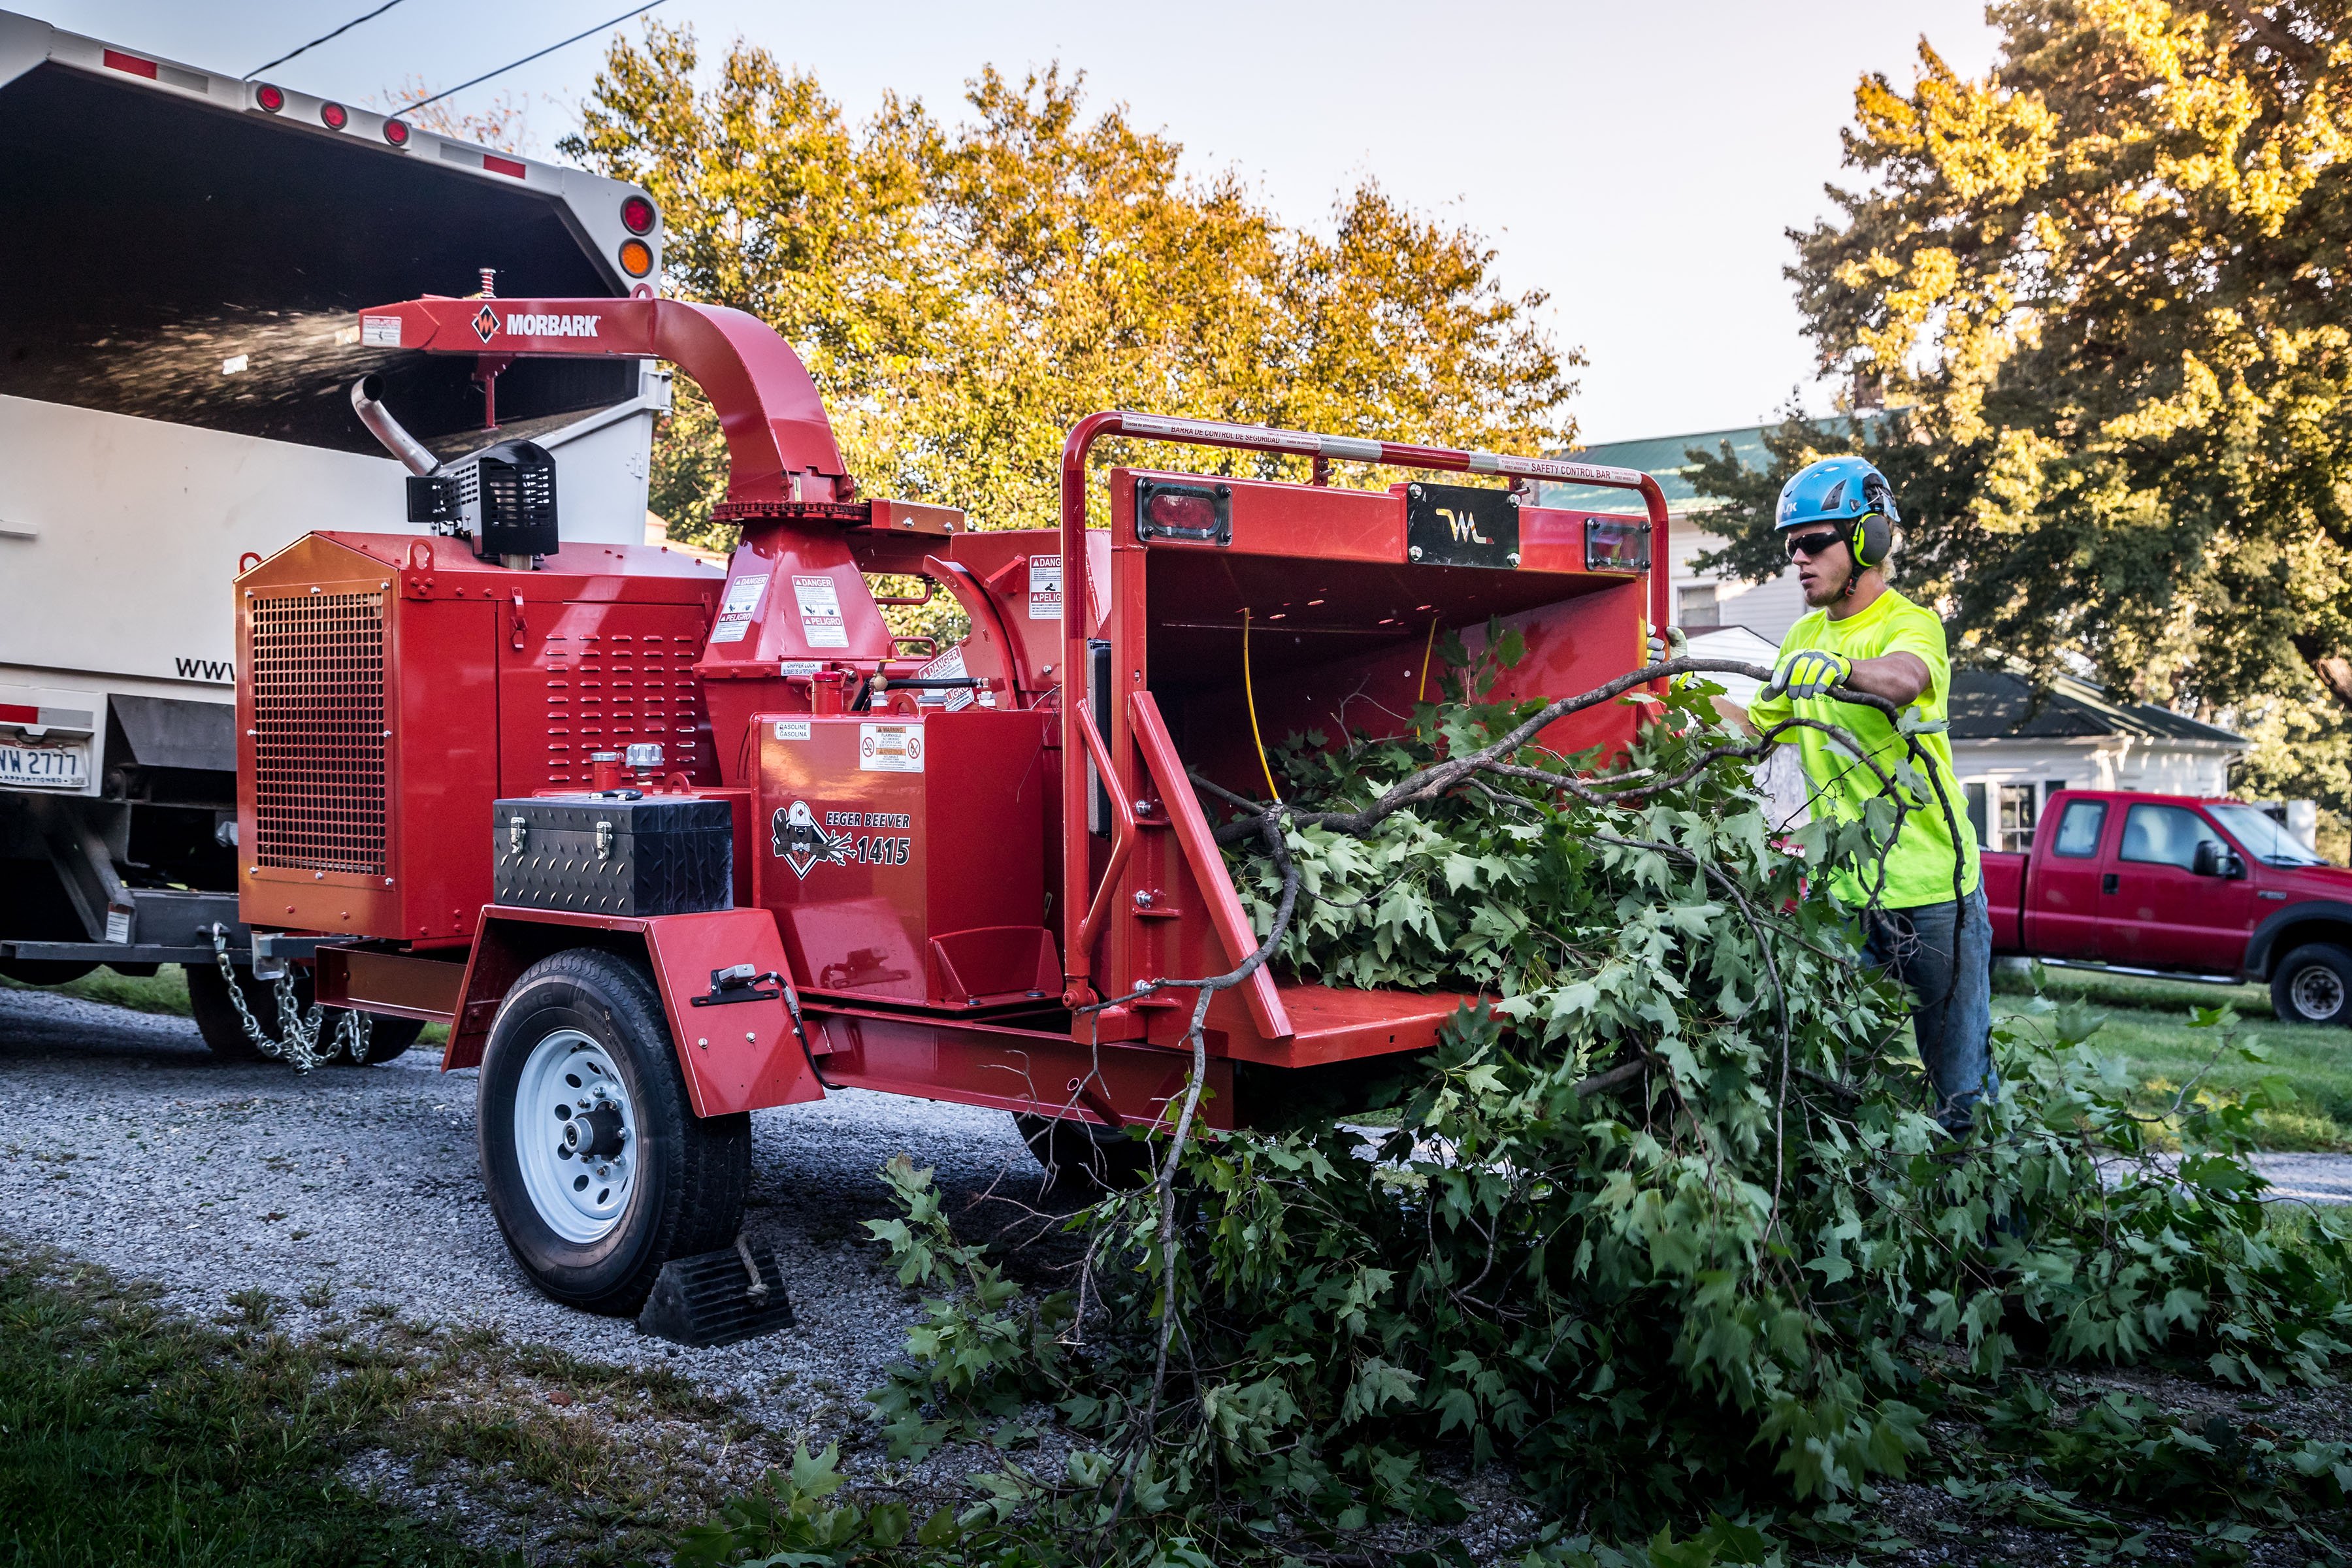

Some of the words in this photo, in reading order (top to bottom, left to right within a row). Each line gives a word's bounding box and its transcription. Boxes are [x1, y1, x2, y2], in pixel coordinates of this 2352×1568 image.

[506, 314, 598, 337] MORBARK
[1171, 426, 1193, 435] BARRA
[1205, 429, 1234, 439] CONTROL
[1245, 434, 1281, 444] SEGURIDAD
[1531, 463, 1559, 474] SAFETY
[1561, 466, 1594, 478] CONTROL
[1596, 470, 1611, 479] BAR
[1039, 558, 1061, 567] DANG
[740, 576, 766, 585] DANGER
[801, 578, 832, 587] DANGER
[1039, 593, 1061, 602] PELIG
[725, 613, 751, 621] PELIGRO
[810, 617, 841, 625] PELIGRO
[928, 649, 958, 676] DANGER
[945, 687, 969, 702] LIGRO
[27, 751, 76, 775] 2777
[826, 811, 862, 826] EEGER
[864, 812, 911, 828] BEEVER
[857, 836, 911, 866] 1415
